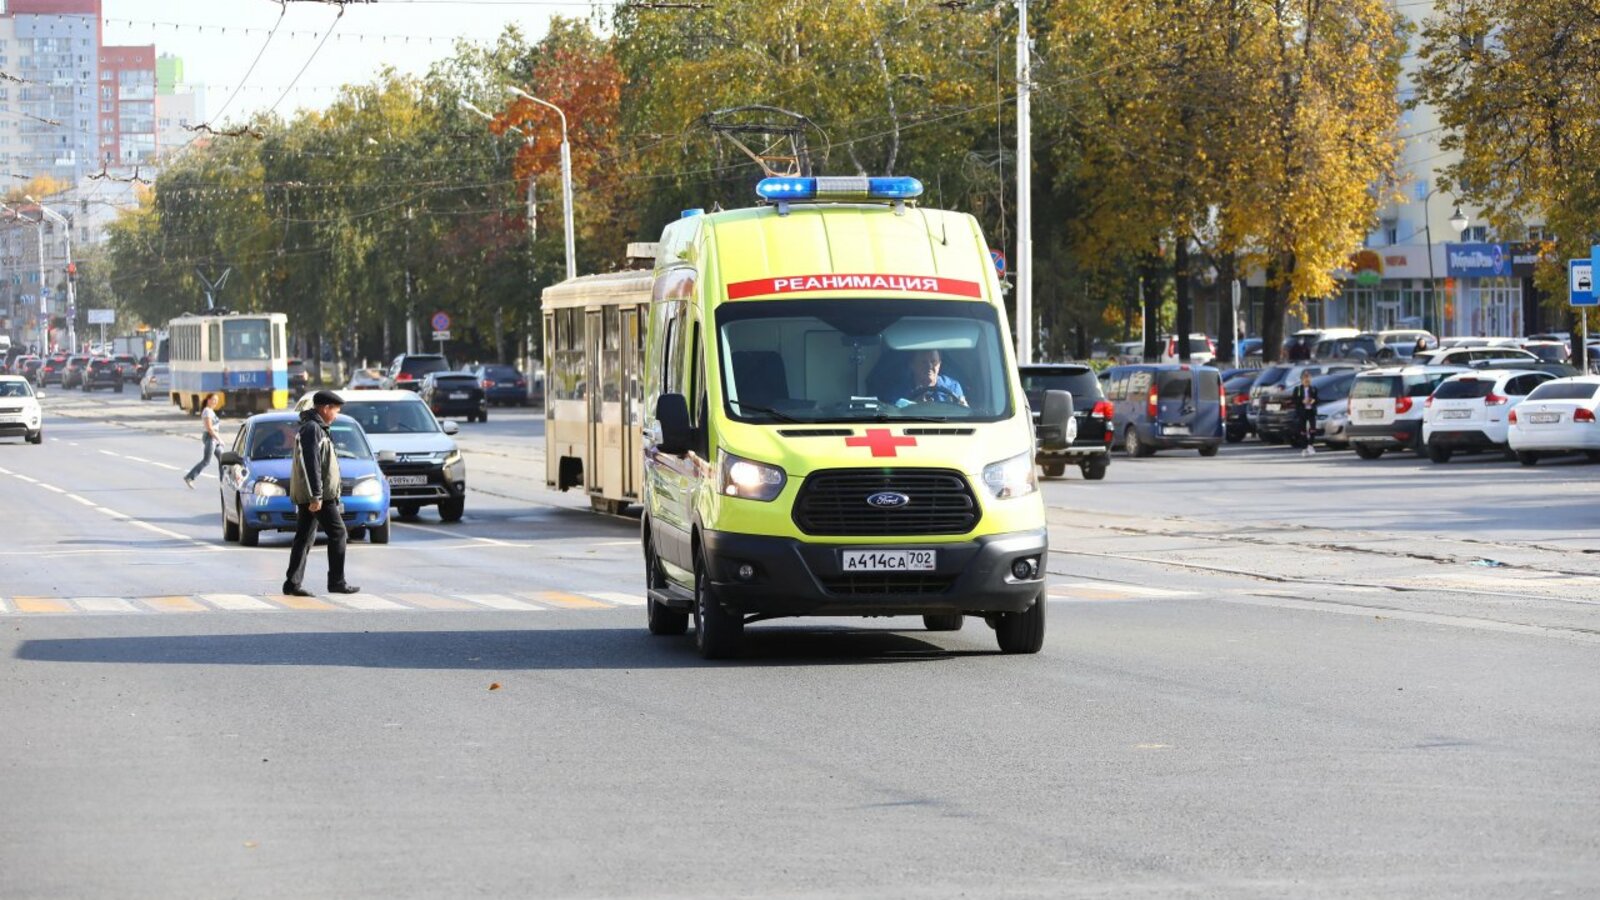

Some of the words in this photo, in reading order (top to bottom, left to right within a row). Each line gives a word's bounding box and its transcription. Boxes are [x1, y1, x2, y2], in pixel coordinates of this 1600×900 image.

[773, 276, 938, 292] РЕАНИМАЦИЯ
[876, 495, 899, 505] Ford
[848, 553, 906, 569] А414СА
[909, 552, 931, 564] 702
